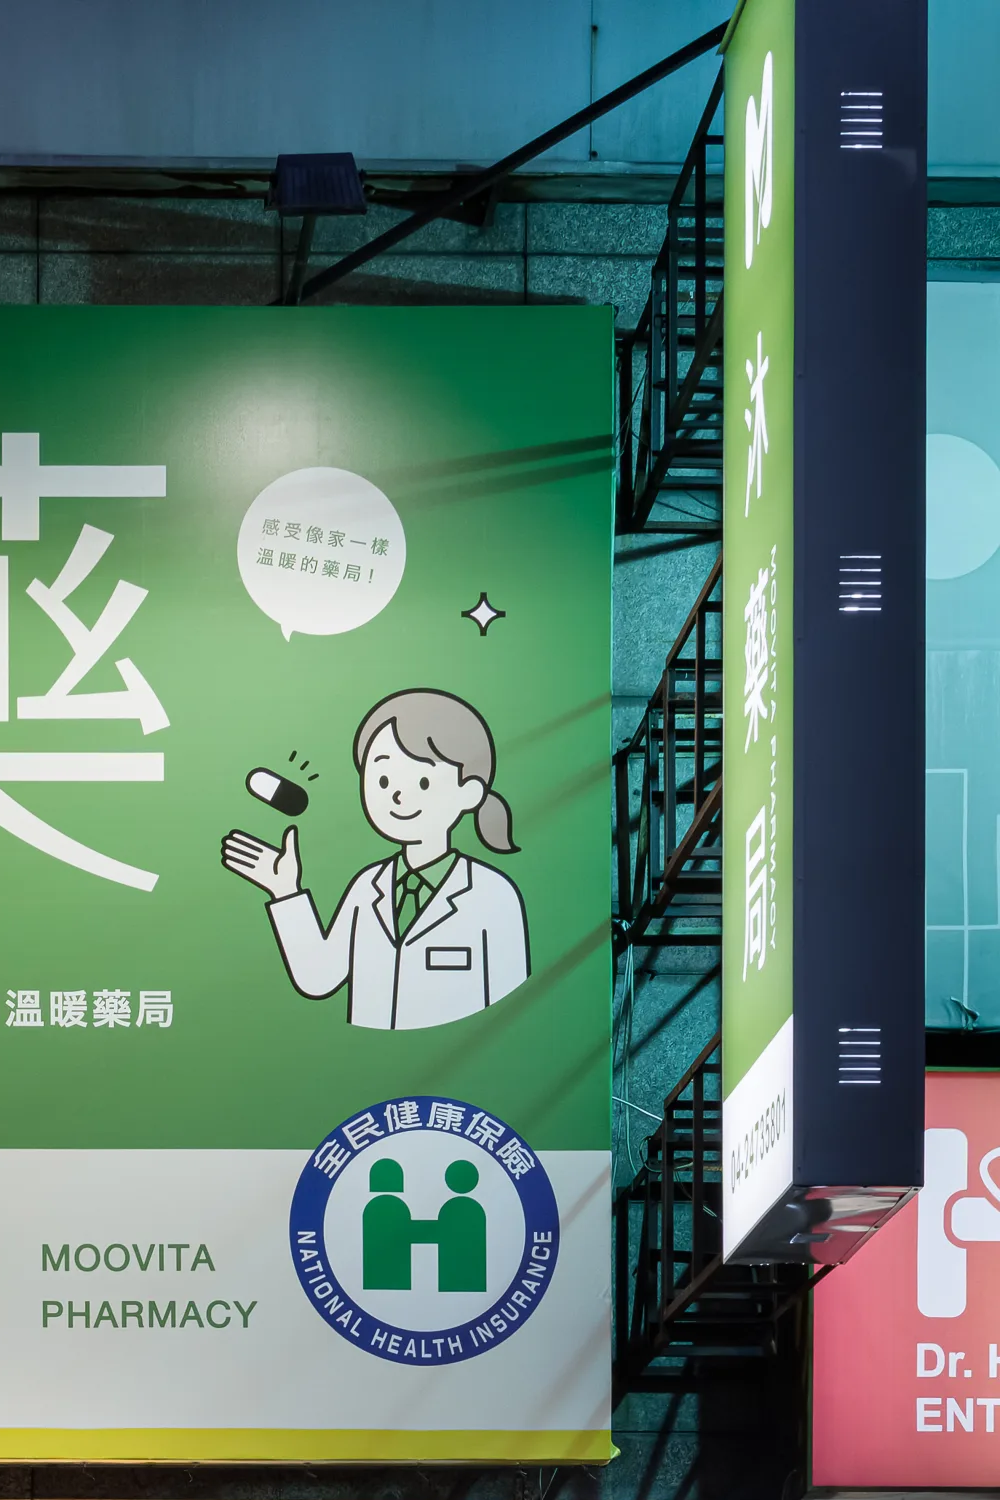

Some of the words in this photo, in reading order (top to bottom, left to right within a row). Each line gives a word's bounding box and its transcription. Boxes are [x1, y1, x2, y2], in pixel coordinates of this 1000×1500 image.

[261, 518, 390, 556] 感受像家一樣
[313, 1100, 535, 1180] 全民健康保險
[40, 1243, 216, 1273] MOOVITA
[297, 1230, 361, 1338] NATIONAL
[370, 1328, 463, 1359] HEALTH
[470, 1230, 552, 1348] INSURANCE
[41, 1300, 259, 1330] PHARMACY
[916, 1343, 972, 1378] Dr.
[916, 1397, 1000, 1433] ENT
